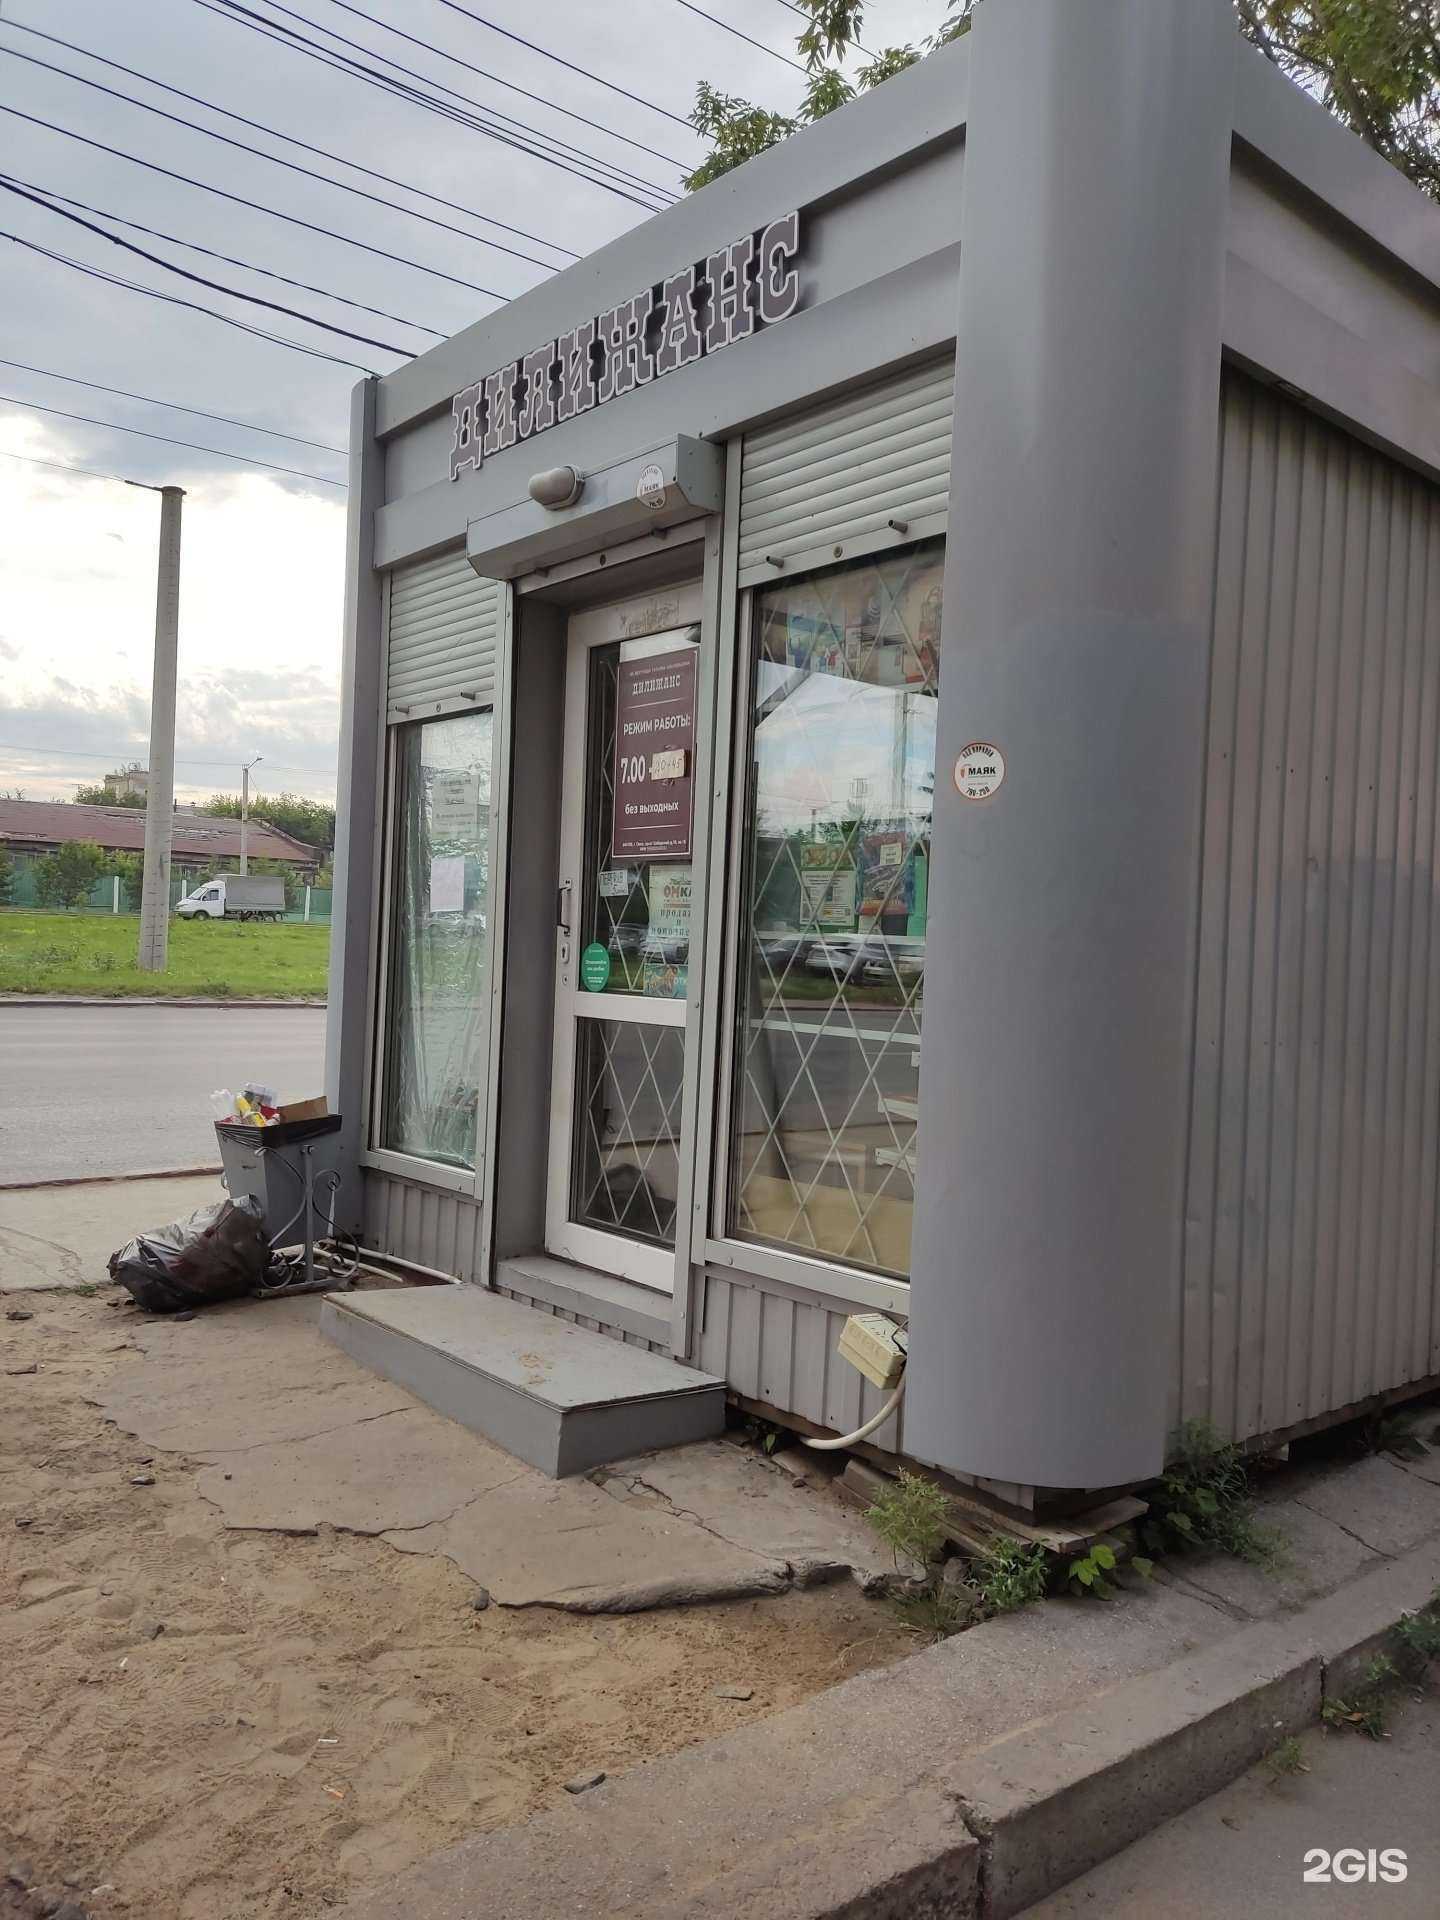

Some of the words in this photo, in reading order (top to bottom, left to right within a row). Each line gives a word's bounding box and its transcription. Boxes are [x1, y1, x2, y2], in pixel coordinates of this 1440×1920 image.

[449, 211, 799, 481] ДИЛИЖАНС
[632, 674, 681, 697] ДИЛИЖАНС
[623, 719, 653, 736] РЕЖИМ
[654, 714, 691, 732] РАБОТЫ:
[620, 755, 646, 784] 7.00
[968, 766, 997, 776] МАЯК
[625, 803, 638, 815] без
[639, 801, 679, 814] выходных
